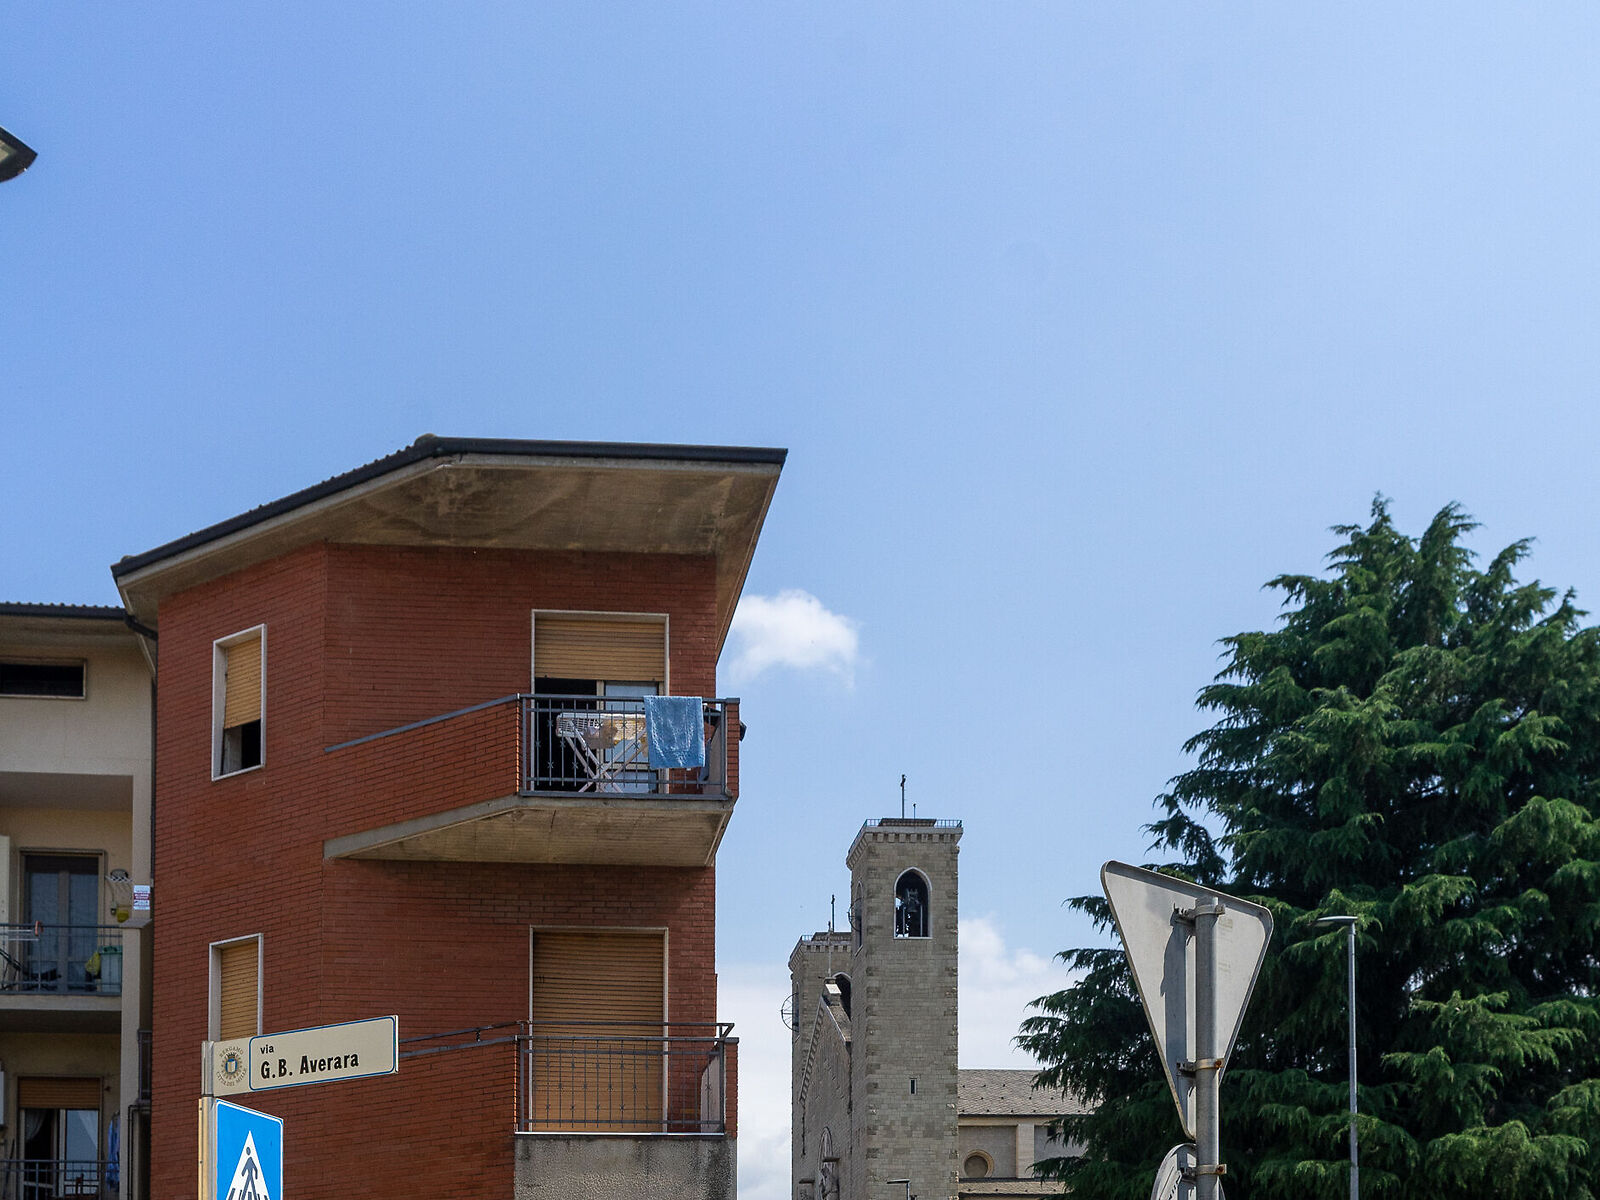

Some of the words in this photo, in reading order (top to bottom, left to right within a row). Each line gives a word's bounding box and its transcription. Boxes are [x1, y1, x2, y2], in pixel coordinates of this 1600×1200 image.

[219, 1046, 244, 1057] BERGAMO
[260, 1044, 274, 1055] via
[260, 1059, 293, 1079] G.B.
[300, 1053, 359, 1074] Averara
